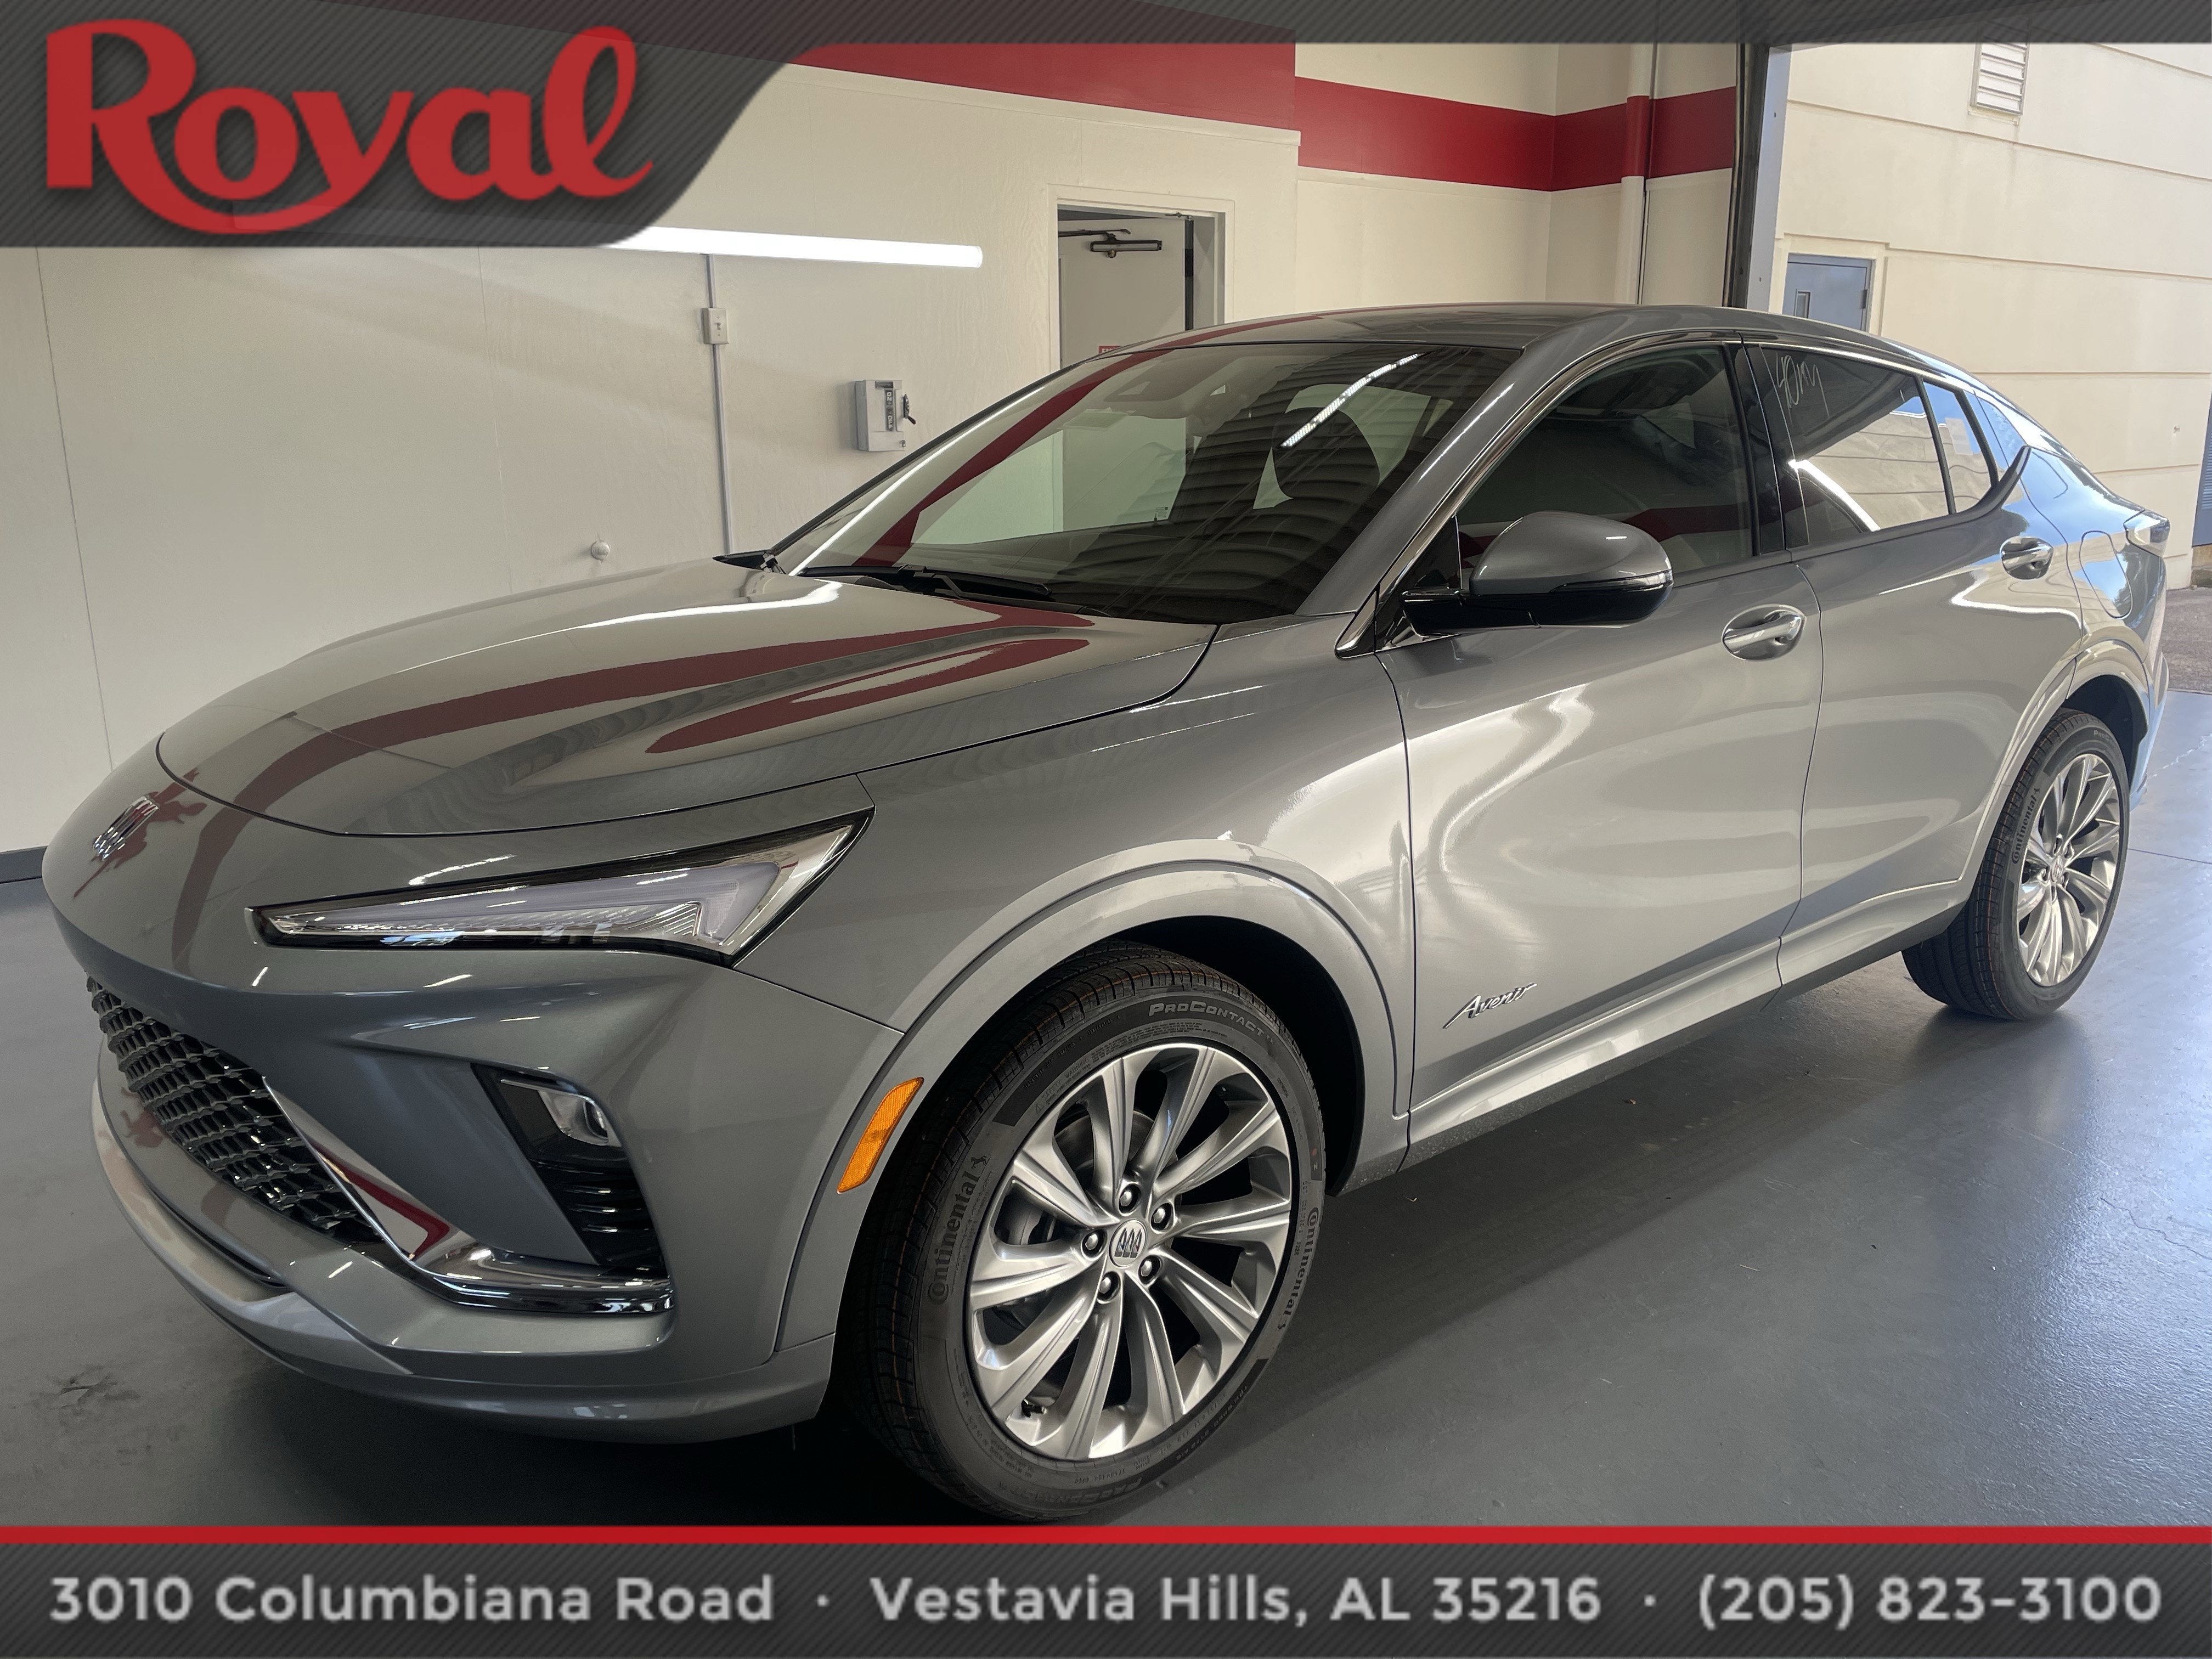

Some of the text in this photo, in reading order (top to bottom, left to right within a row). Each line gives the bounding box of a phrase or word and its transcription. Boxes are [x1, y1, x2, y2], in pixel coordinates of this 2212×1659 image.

[887, 392, 892, 401] ON
[2011, 795, 2037, 865] Continental
[1443, 983, 1537, 1029] Avenir
[928, 1171, 980, 1305] Continental
[1283, 1207, 1319, 1316] Continental
